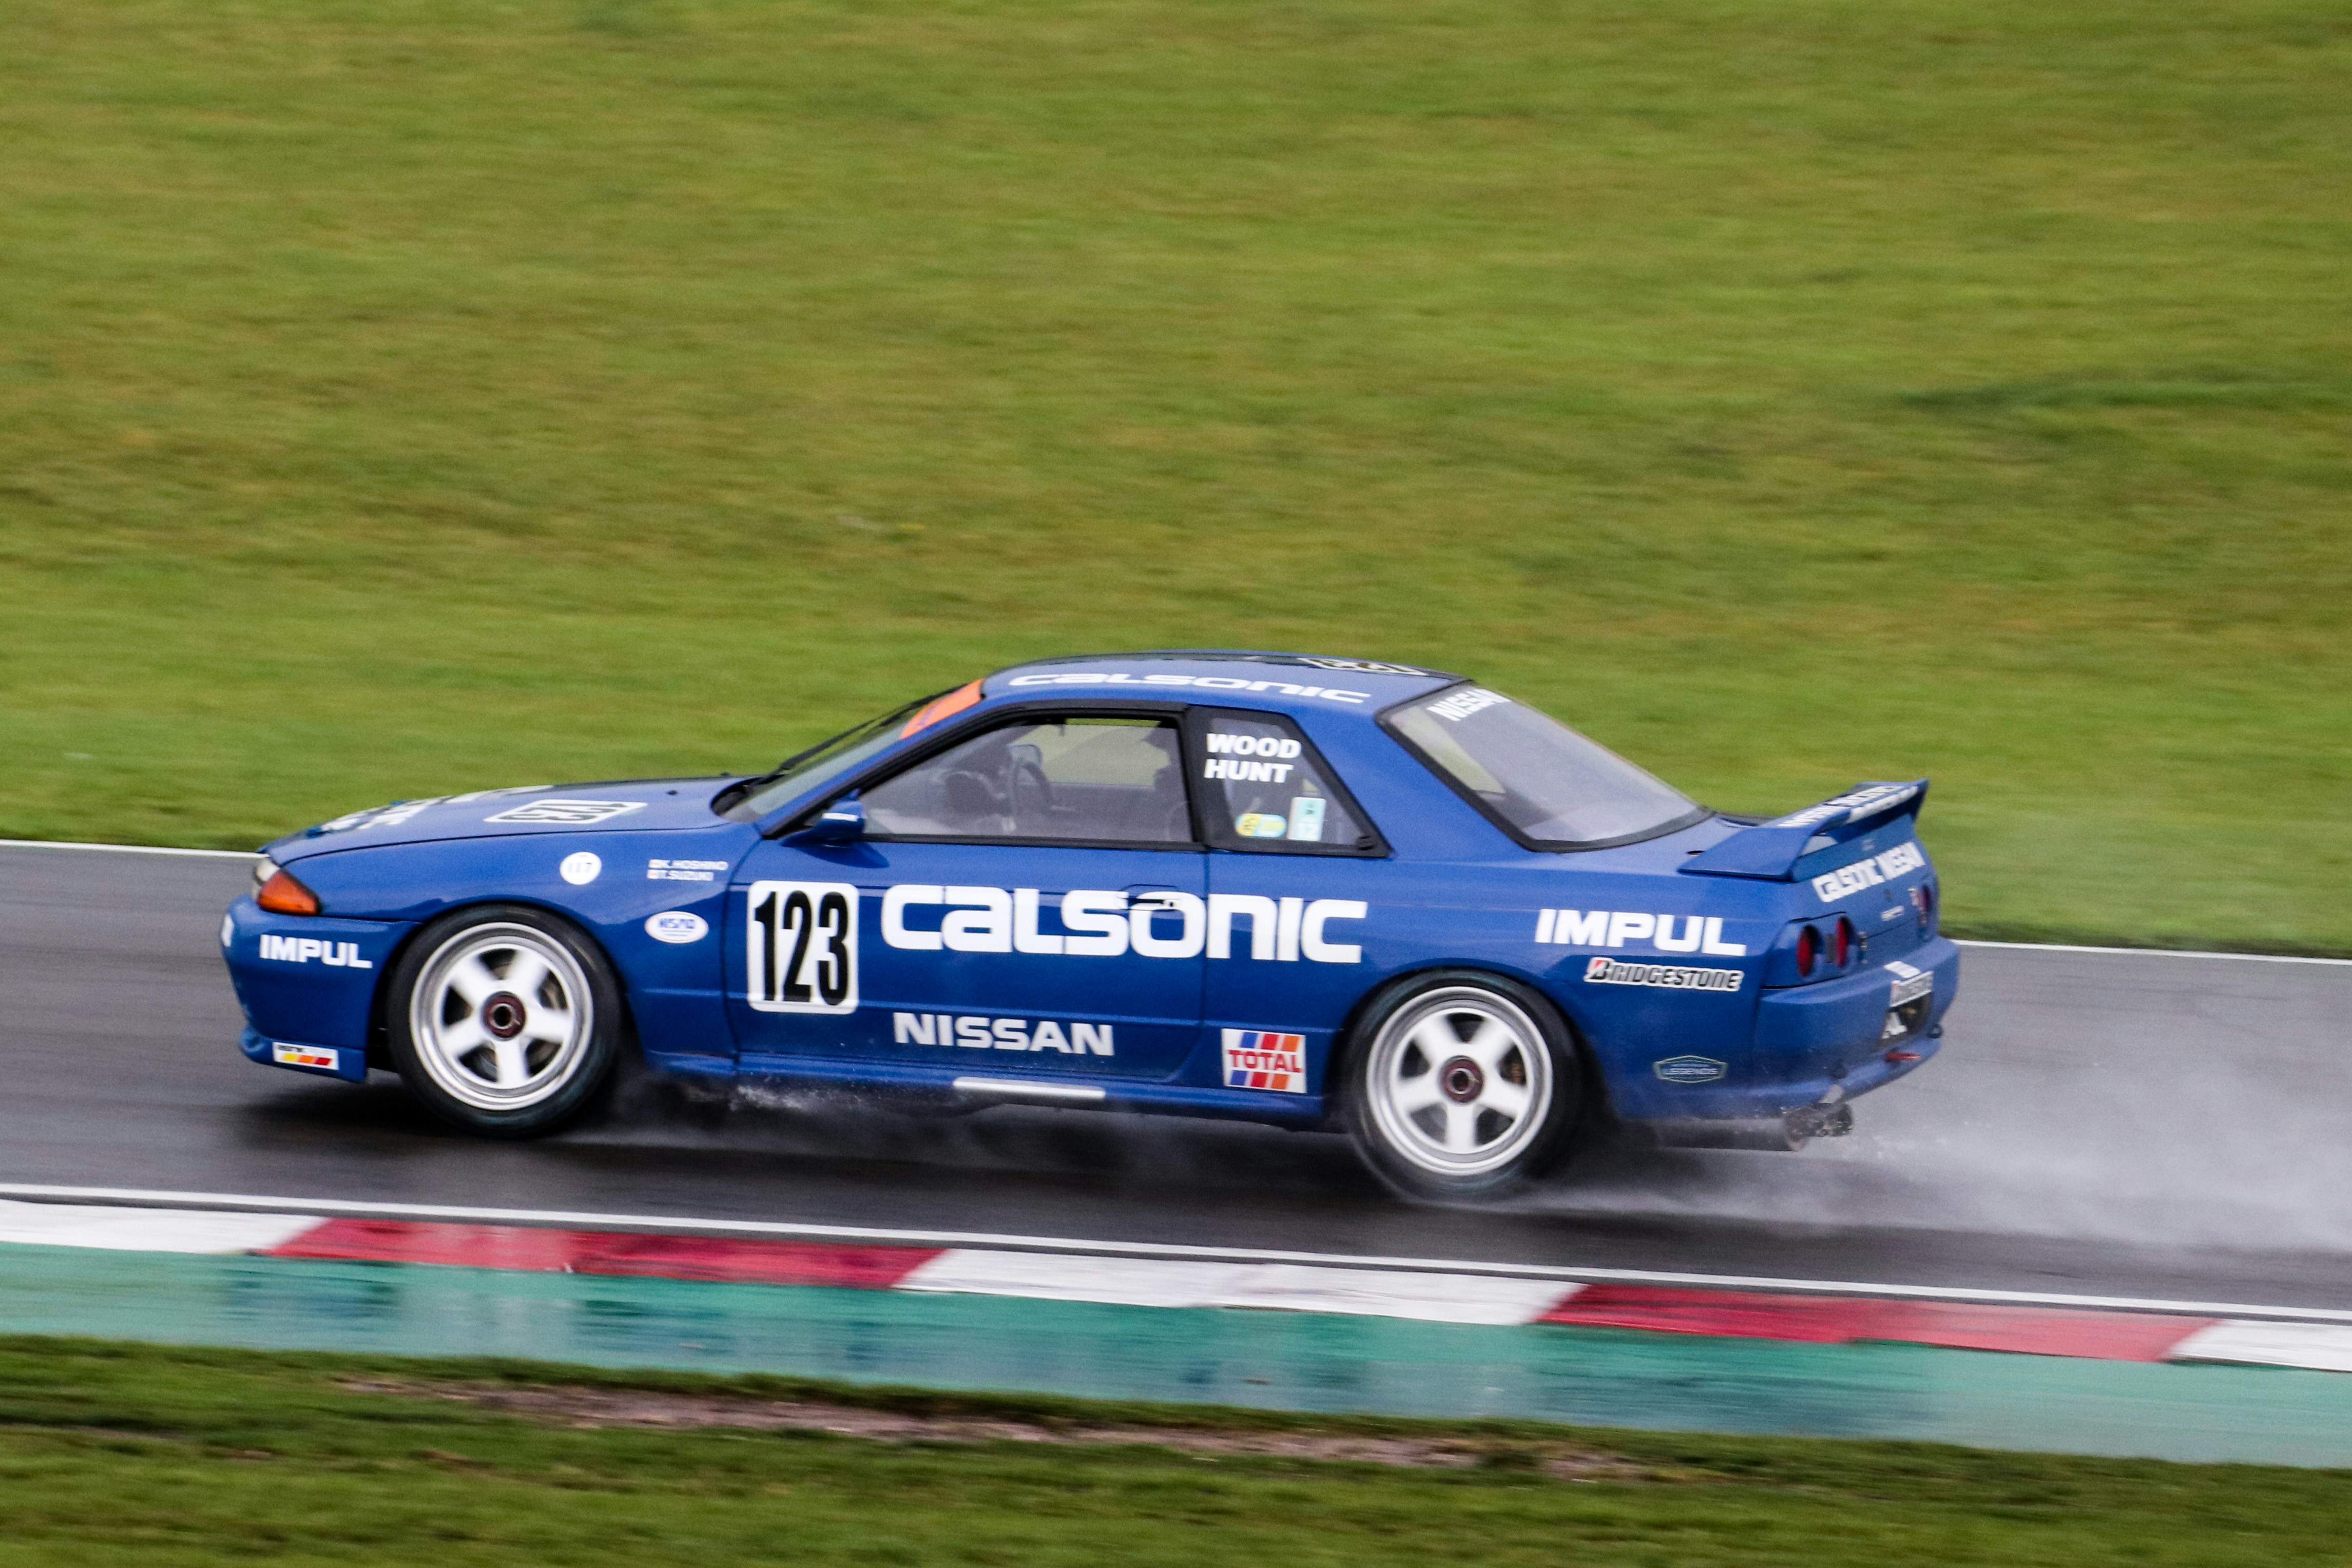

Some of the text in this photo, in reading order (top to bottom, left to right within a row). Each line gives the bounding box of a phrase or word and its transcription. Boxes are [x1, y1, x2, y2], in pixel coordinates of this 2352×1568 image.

[1426, 689, 1511, 721] NISSAN
[1207, 733, 1301, 758] WOOD
[1204, 759, 1294, 783] HUNT
[754, 891, 849, 1006] 123
[1535, 908, 1747, 957] IMPUL
[260, 934, 373, 969] IMPUL
[1591, 960, 1742, 990] BRIDGESTONE
[894, 1012, 1114, 1056] NISSAN
[1228, 1050, 1302, 1073] TOTAL
